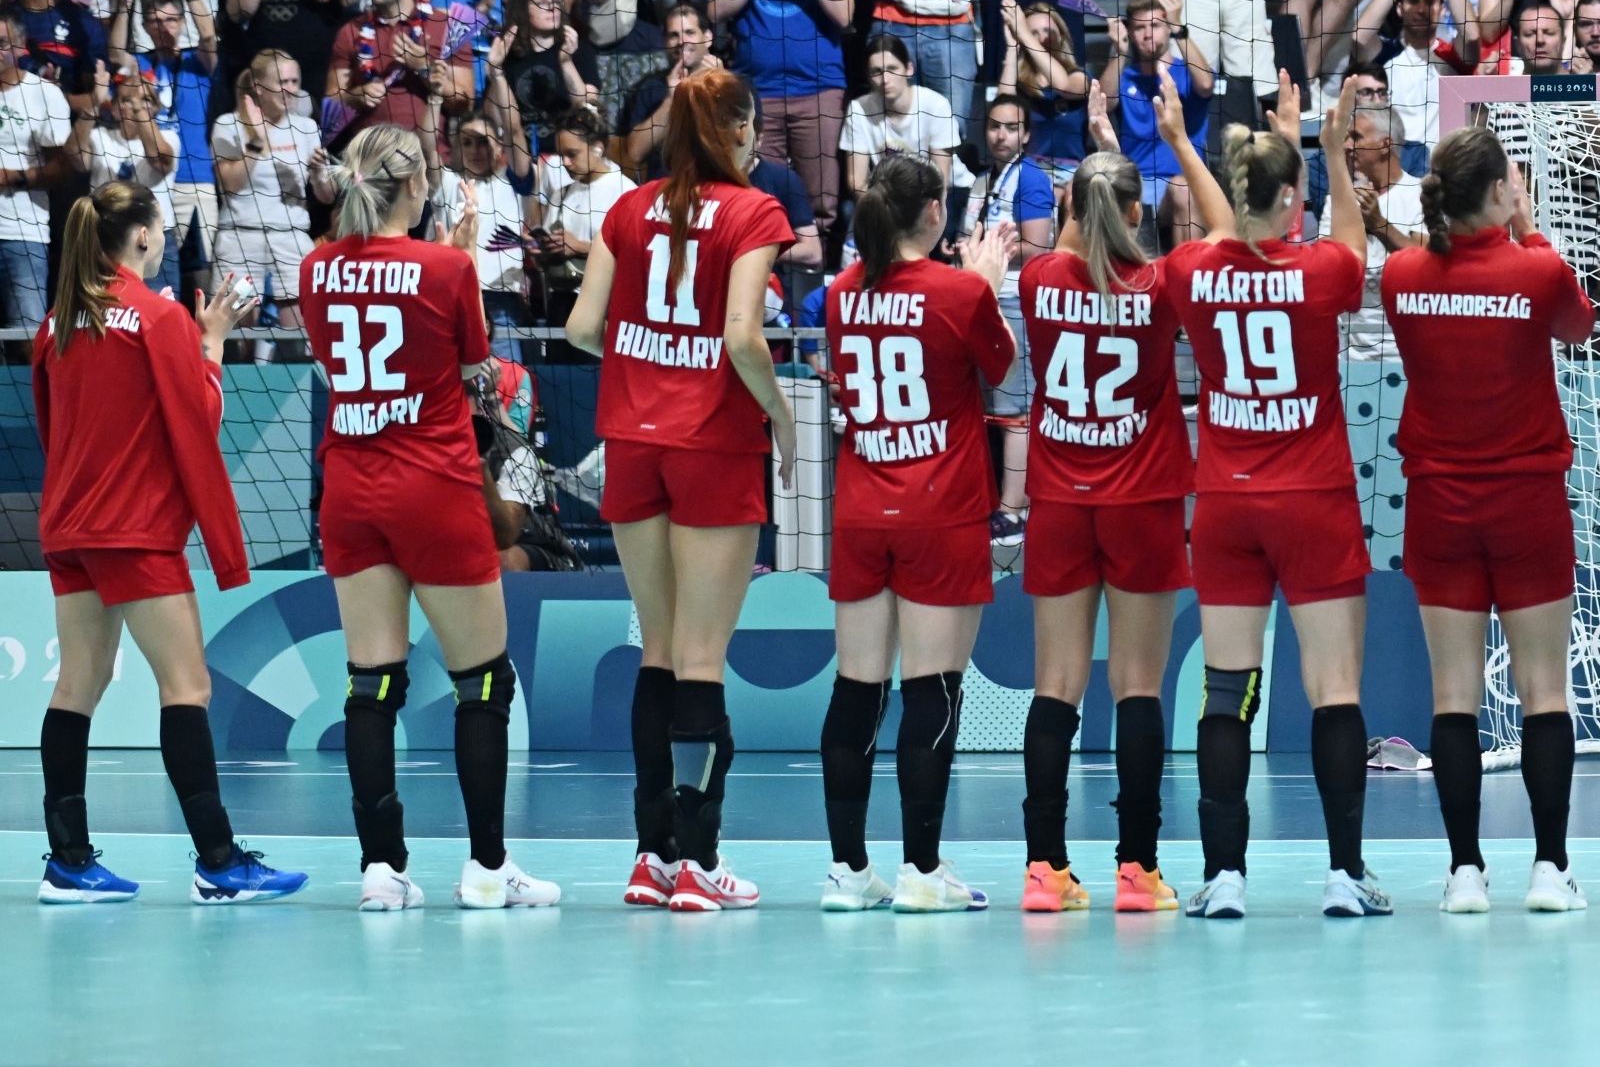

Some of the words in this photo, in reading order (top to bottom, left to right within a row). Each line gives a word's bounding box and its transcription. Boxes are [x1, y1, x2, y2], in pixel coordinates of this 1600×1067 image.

[1533, 84, 1563, 92] PARIS
[1566, 84, 1594, 92] 2024
[312, 255, 422, 296] PÁSZTOR
[645, 233, 701, 327] 11
[1191, 264, 1305, 304] MÁRTON
[1396, 292, 1531, 320] MAGYARORSZÁG
[327, 304, 407, 393] 32
[614, 320, 724, 370] HUNGARY
[1213, 310, 1297, 396] 19
[840, 335, 931, 425] 38
[1045, 330, 1139, 418] 42
[1038, 403, 1149, 447] HUNGARY
[1208, 395, 1319, 433] HUNGARY
